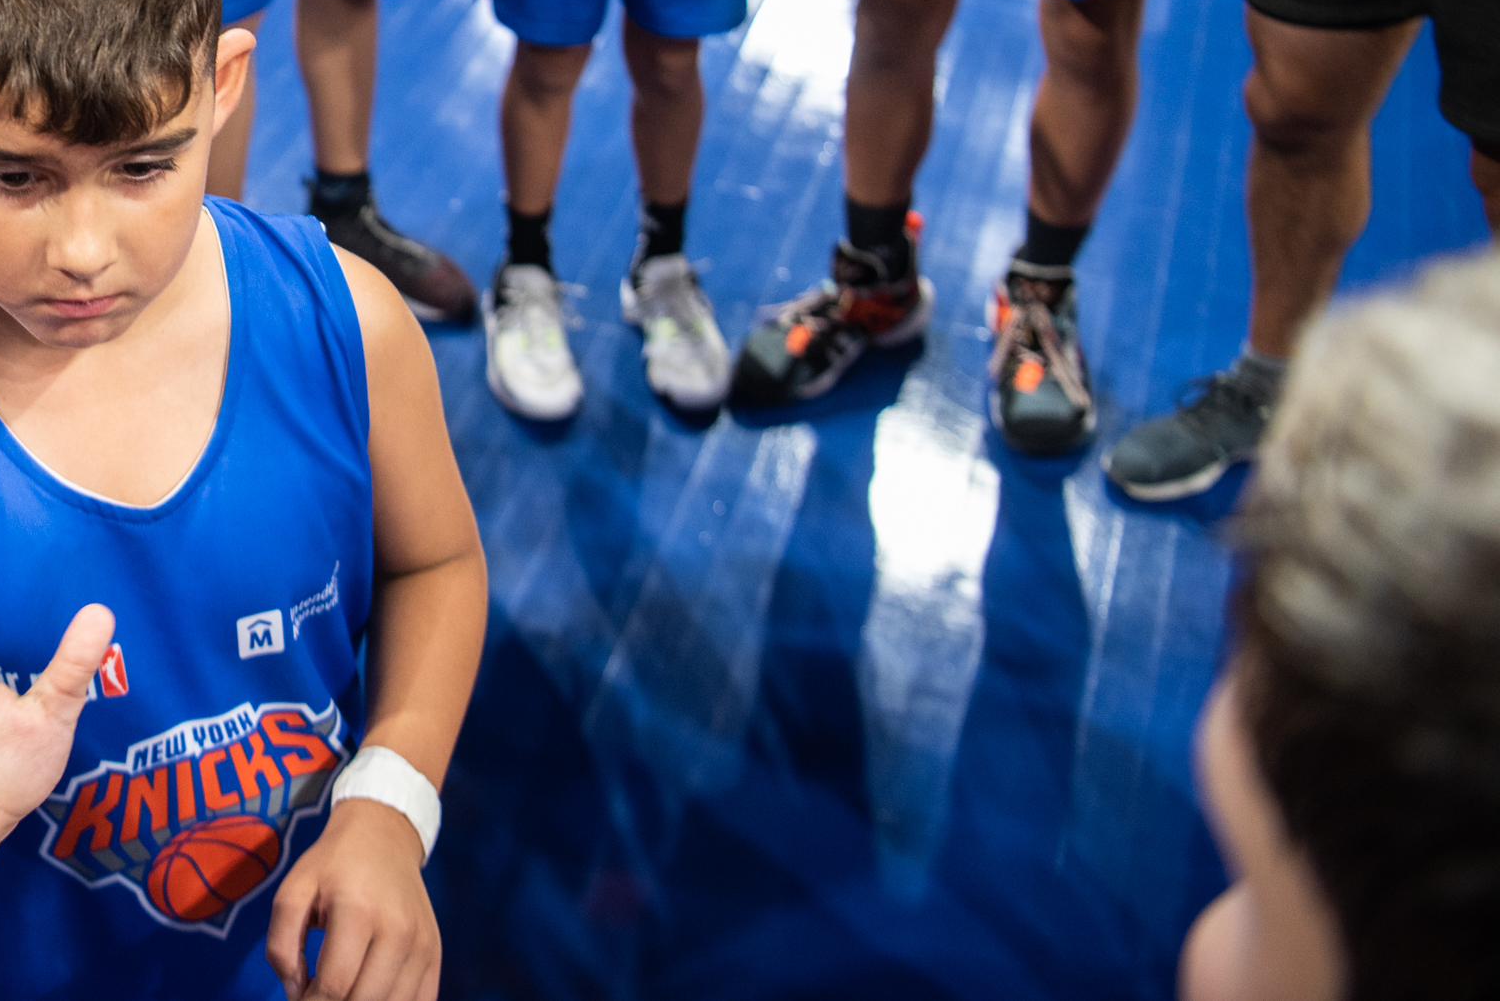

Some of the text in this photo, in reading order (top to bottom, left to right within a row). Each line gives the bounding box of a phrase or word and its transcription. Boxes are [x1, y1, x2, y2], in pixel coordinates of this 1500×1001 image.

[52, 711, 338, 860] KNICKS
[133, 711, 254, 771] NEW YORK
